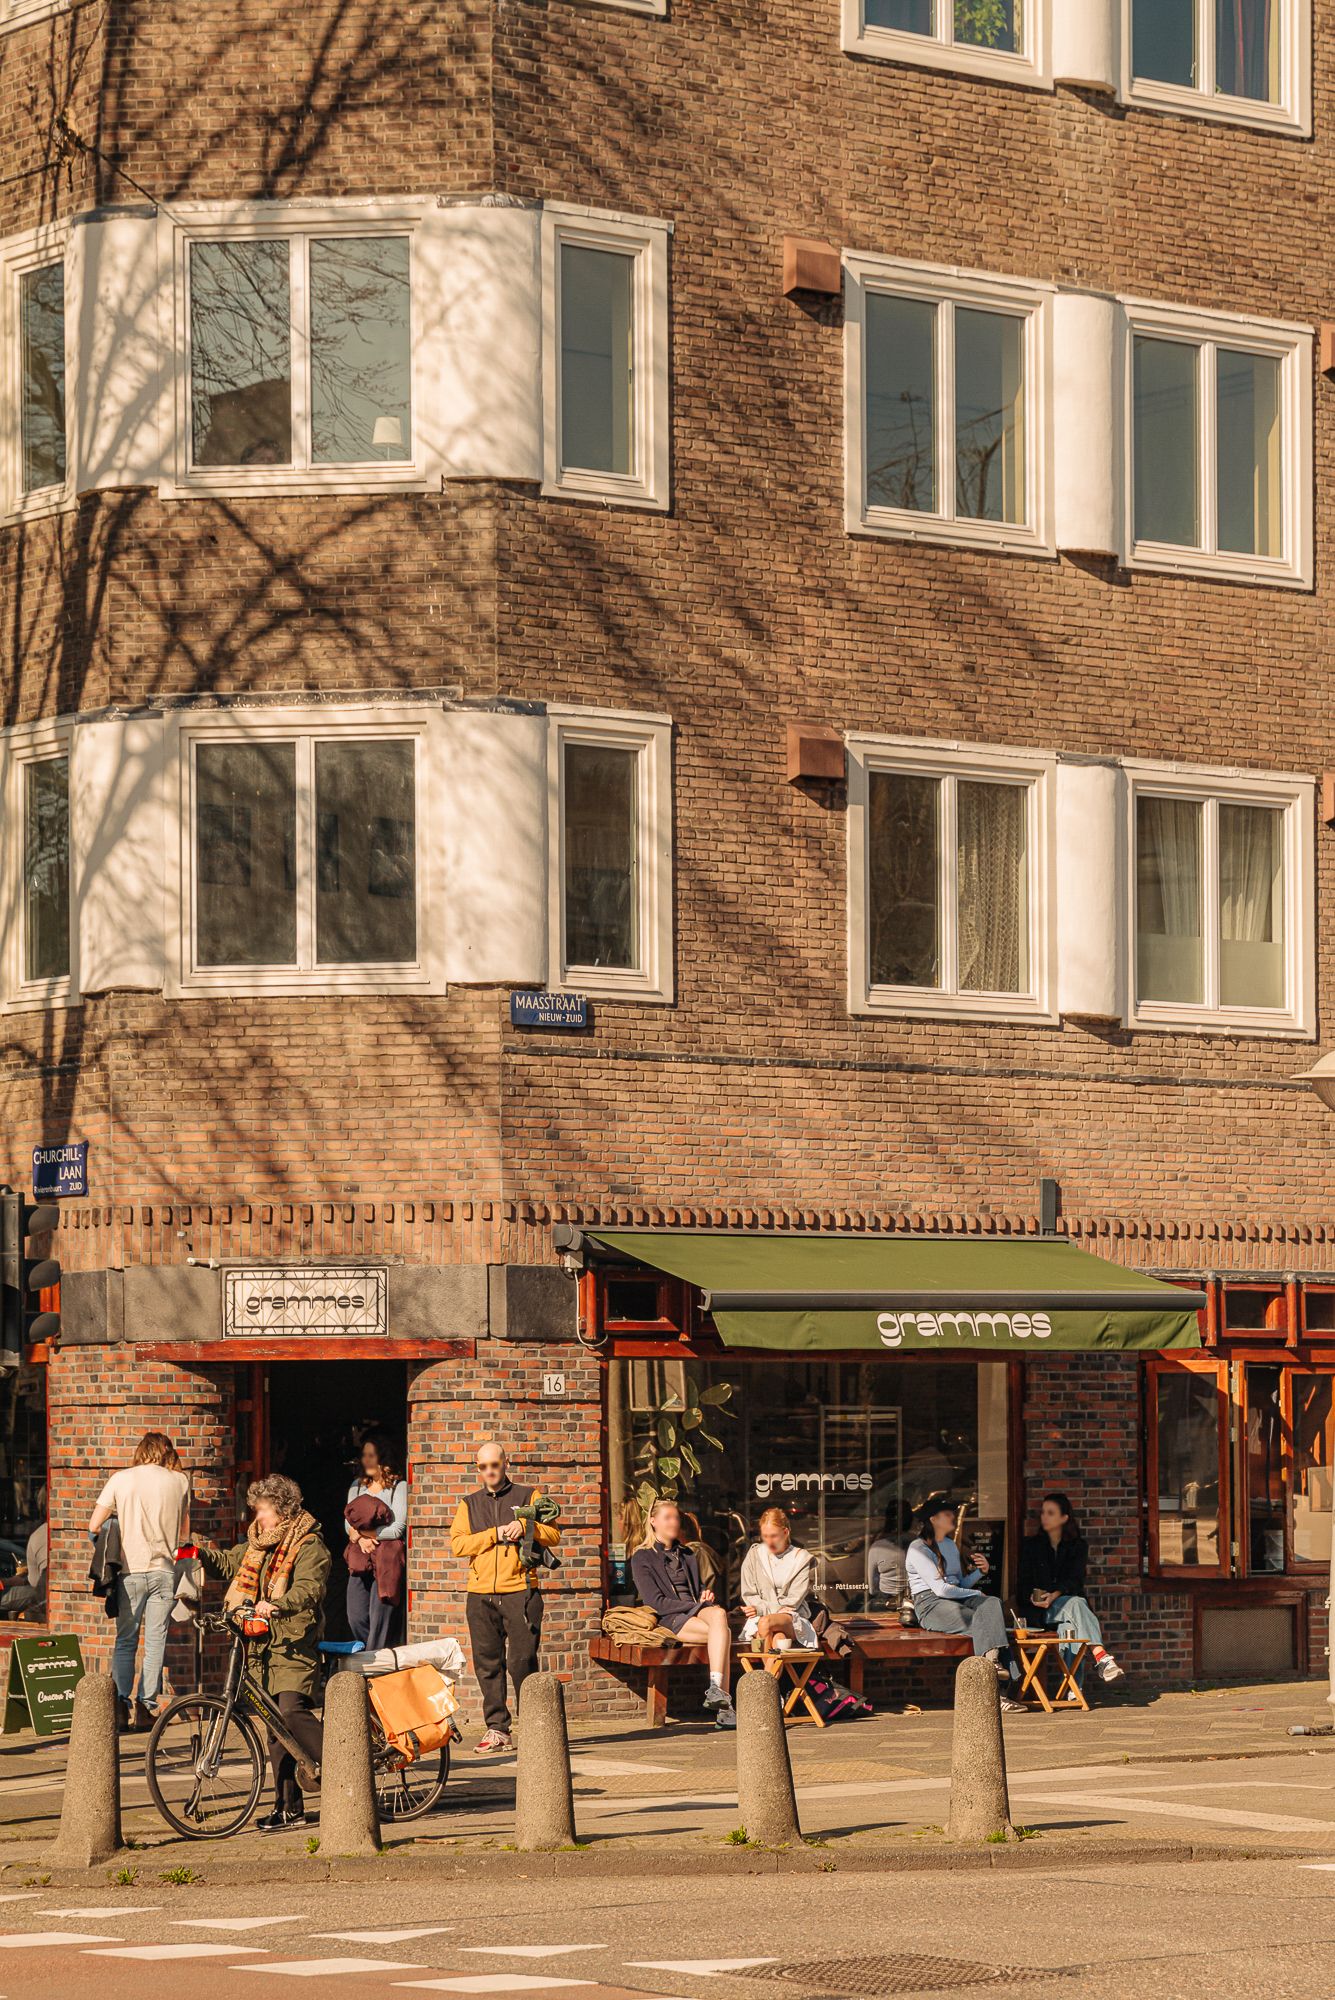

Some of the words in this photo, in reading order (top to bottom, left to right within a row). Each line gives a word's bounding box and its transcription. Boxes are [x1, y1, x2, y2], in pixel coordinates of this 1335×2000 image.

[515, 995, 581, 1011] MAASSTRAAT
[538, 1012, 583, 1023] NIEUW-ZUID
[33, 1147, 82, 1165] CHURCHILL-
[59, 1165, 82, 1180] LAAN
[69, 1181, 83, 1191] ZUID
[246, 1295, 365, 1316] grammes
[876, 1312, 1052, 1347] grammes
[547, 1376, 562, 1392] 16
[755, 1472, 873, 1498] grammes
